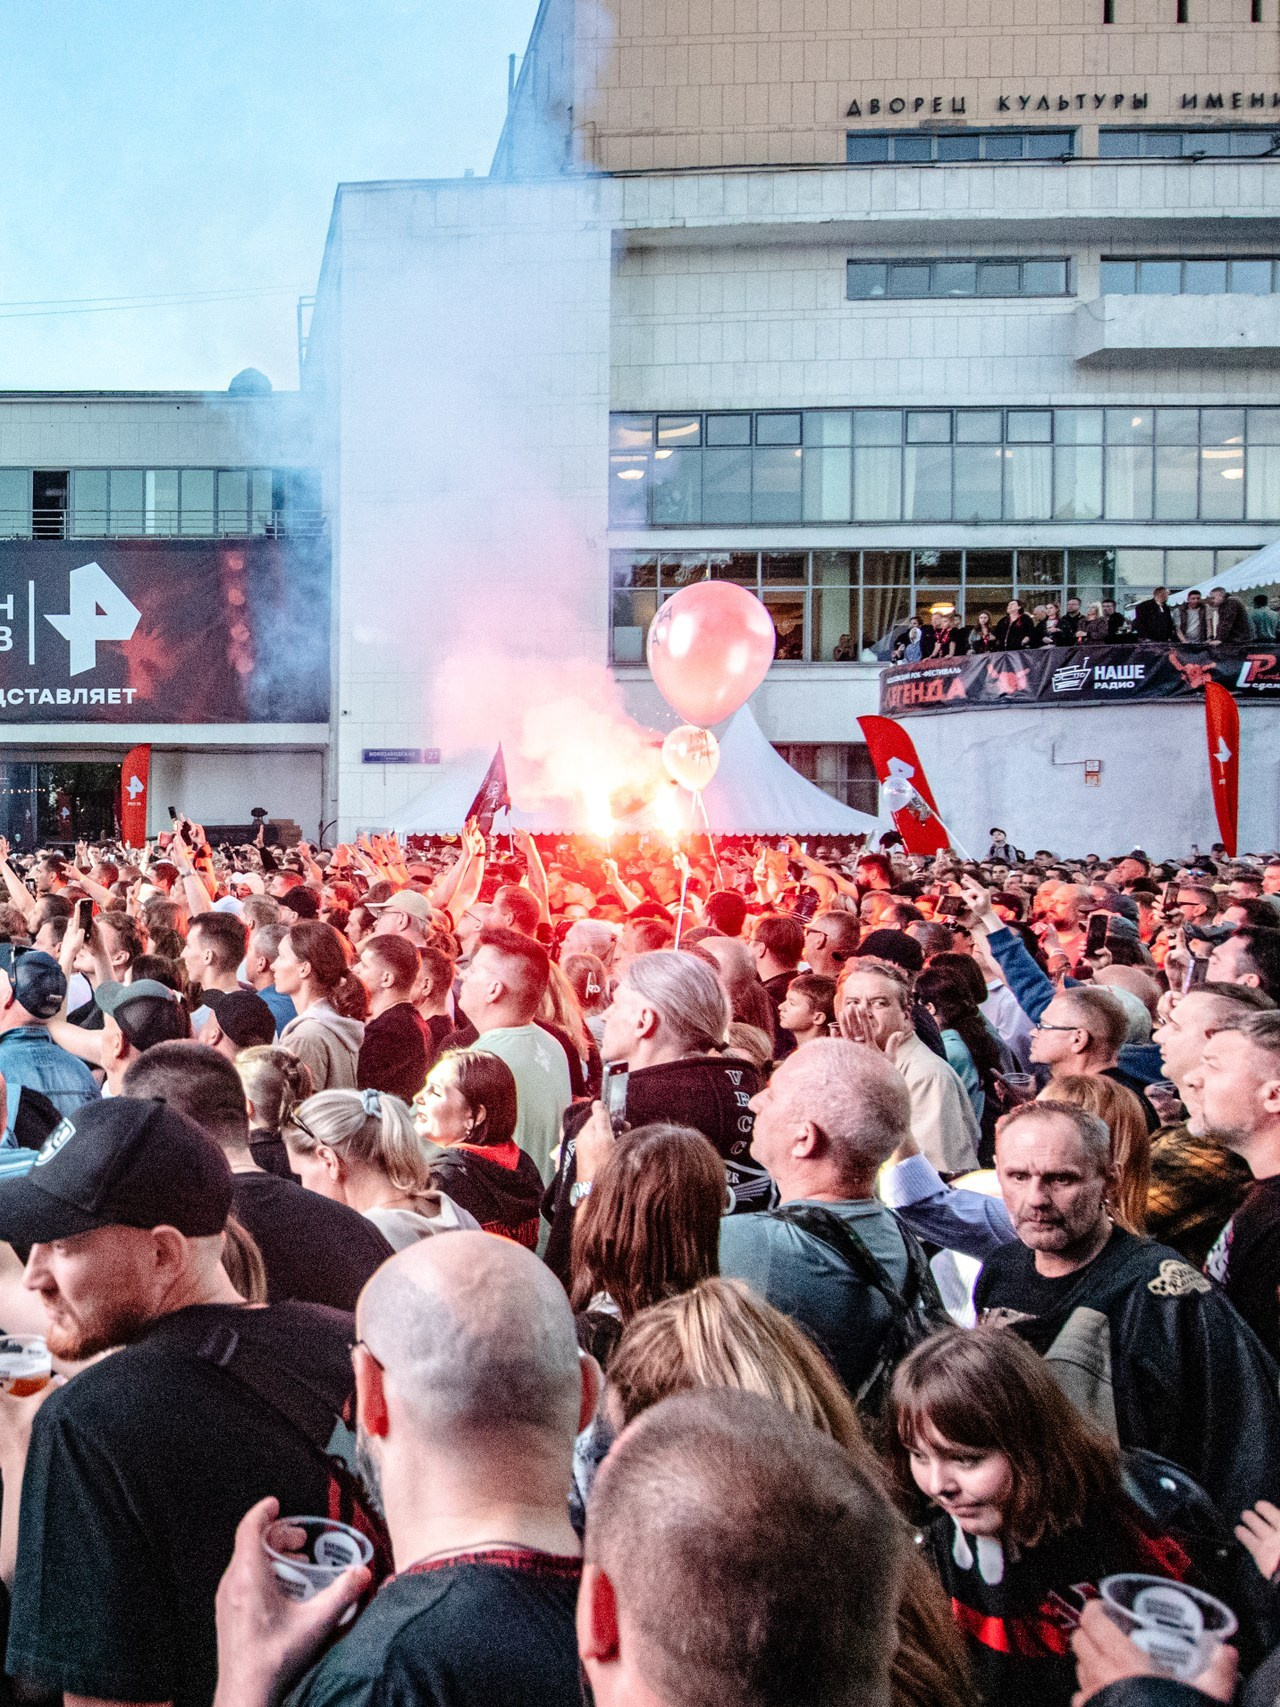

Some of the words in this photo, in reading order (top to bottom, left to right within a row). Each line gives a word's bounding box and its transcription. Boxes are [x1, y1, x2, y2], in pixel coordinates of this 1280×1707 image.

[846, 97, 966, 117] ДВОРЕЦ
[998, 93, 1148, 112] КУЛЬТУРЫ
[1094, 665, 1145, 681] НАШЕ
[1094, 681, 1135, 689] РАДИО
